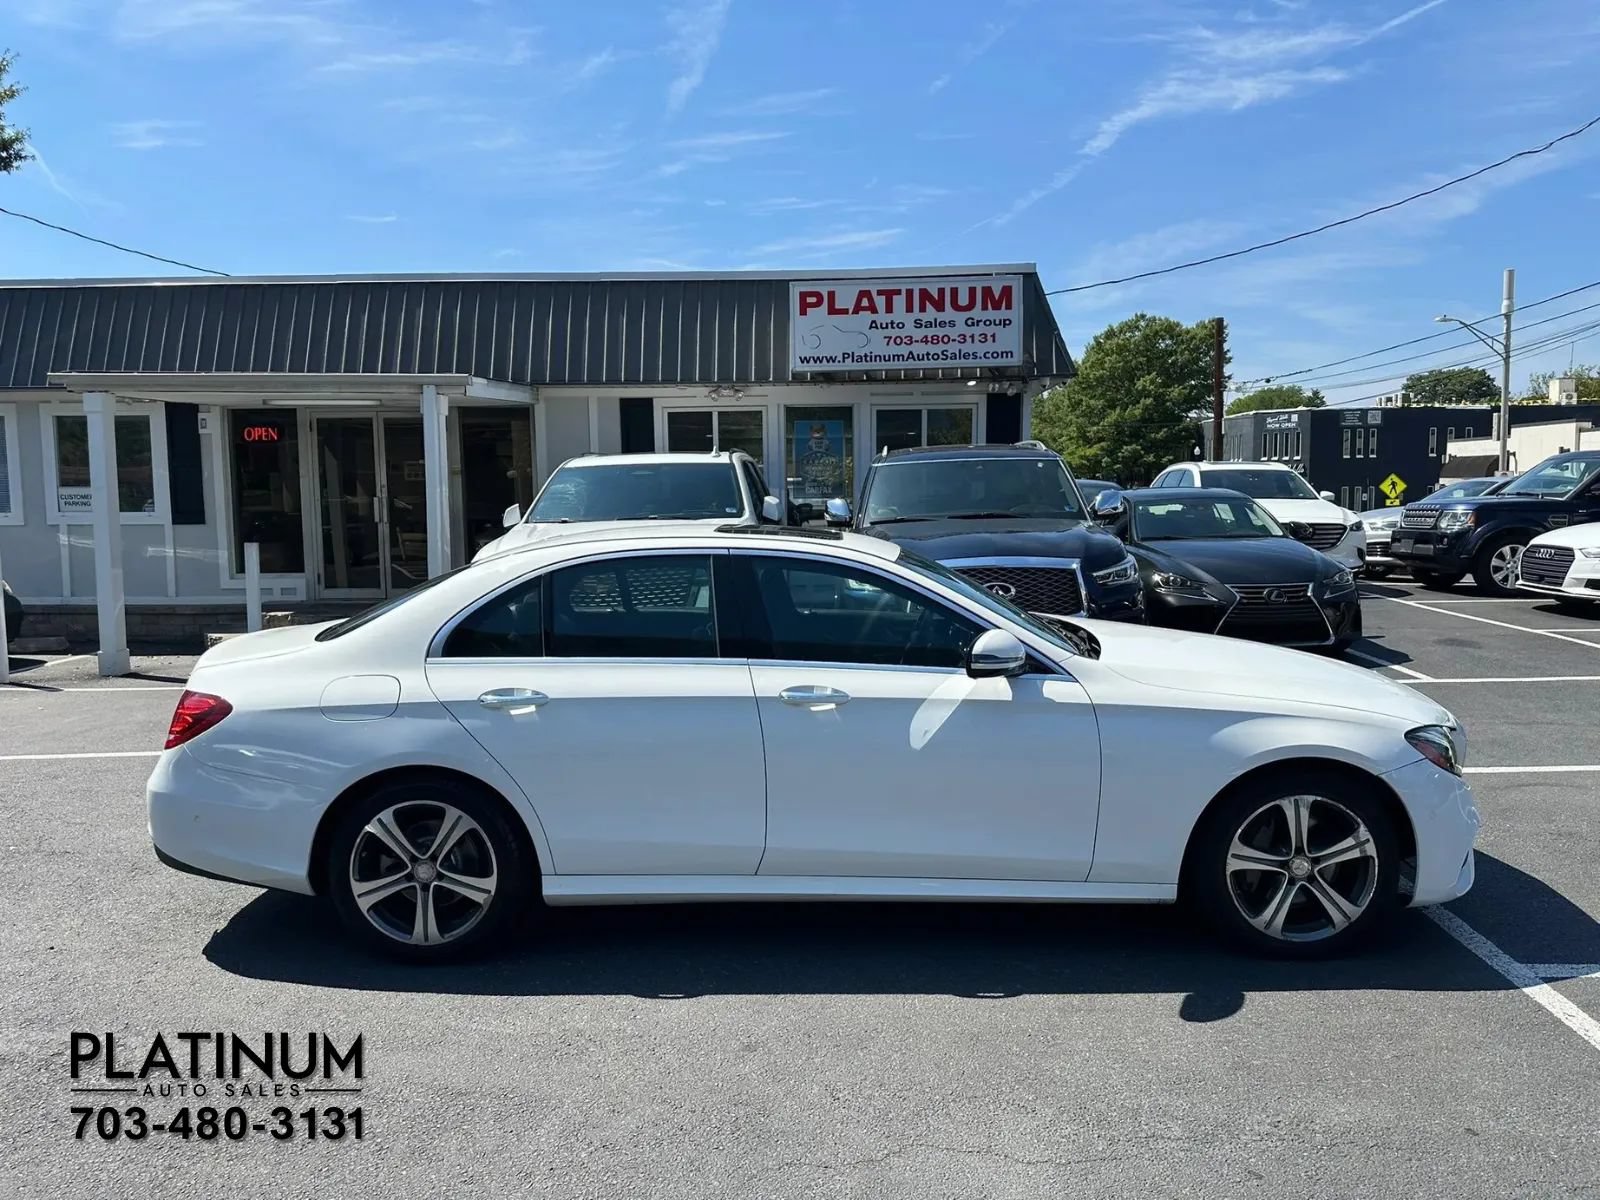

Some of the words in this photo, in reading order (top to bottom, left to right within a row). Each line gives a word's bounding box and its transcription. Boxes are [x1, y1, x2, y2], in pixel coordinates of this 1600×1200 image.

[799, 285, 1013, 316] PLATINUM
[868, 319, 905, 330] Auto
[913, 318, 956, 329] Sales
[964, 317, 1012, 330] Group
[883, 333, 996, 346] 703-480-3131
[799, 349, 1014, 365] www.PlatinumAutoSales.com
[244, 427, 278, 441] OPEN
